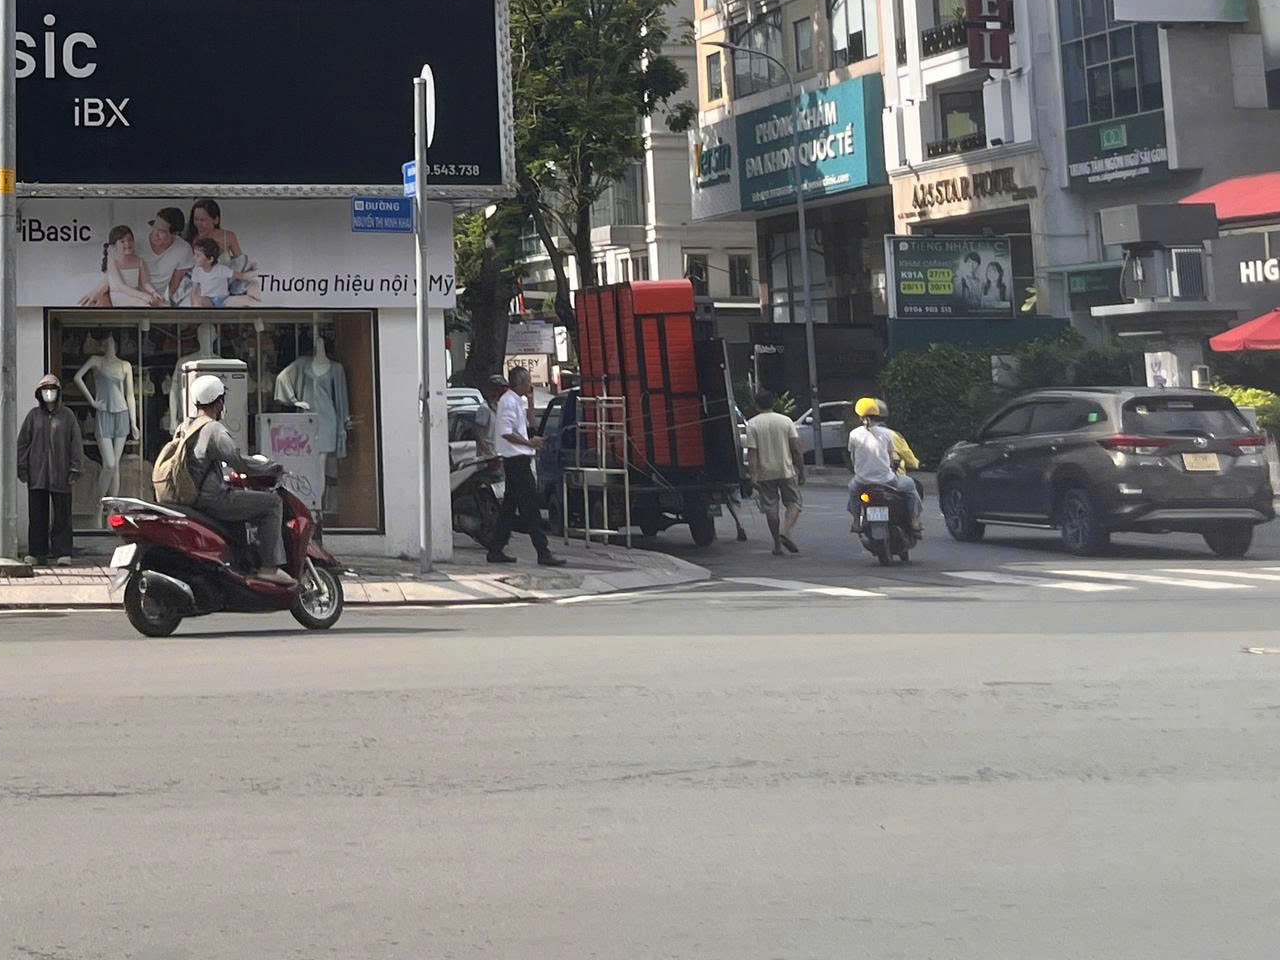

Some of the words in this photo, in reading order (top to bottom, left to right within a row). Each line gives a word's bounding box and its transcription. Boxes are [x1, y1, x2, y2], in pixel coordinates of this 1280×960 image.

[73, 97, 130, 128] iBX
[22, 219, 91, 242] iBasic
[1239, 258, 1280, 284] HIG
[257, 274, 329, 296] Thương
[334, 274, 374, 296] hiệu
[379, 274, 408, 296] nội
[428, 274, 454, 296] Mỹ
